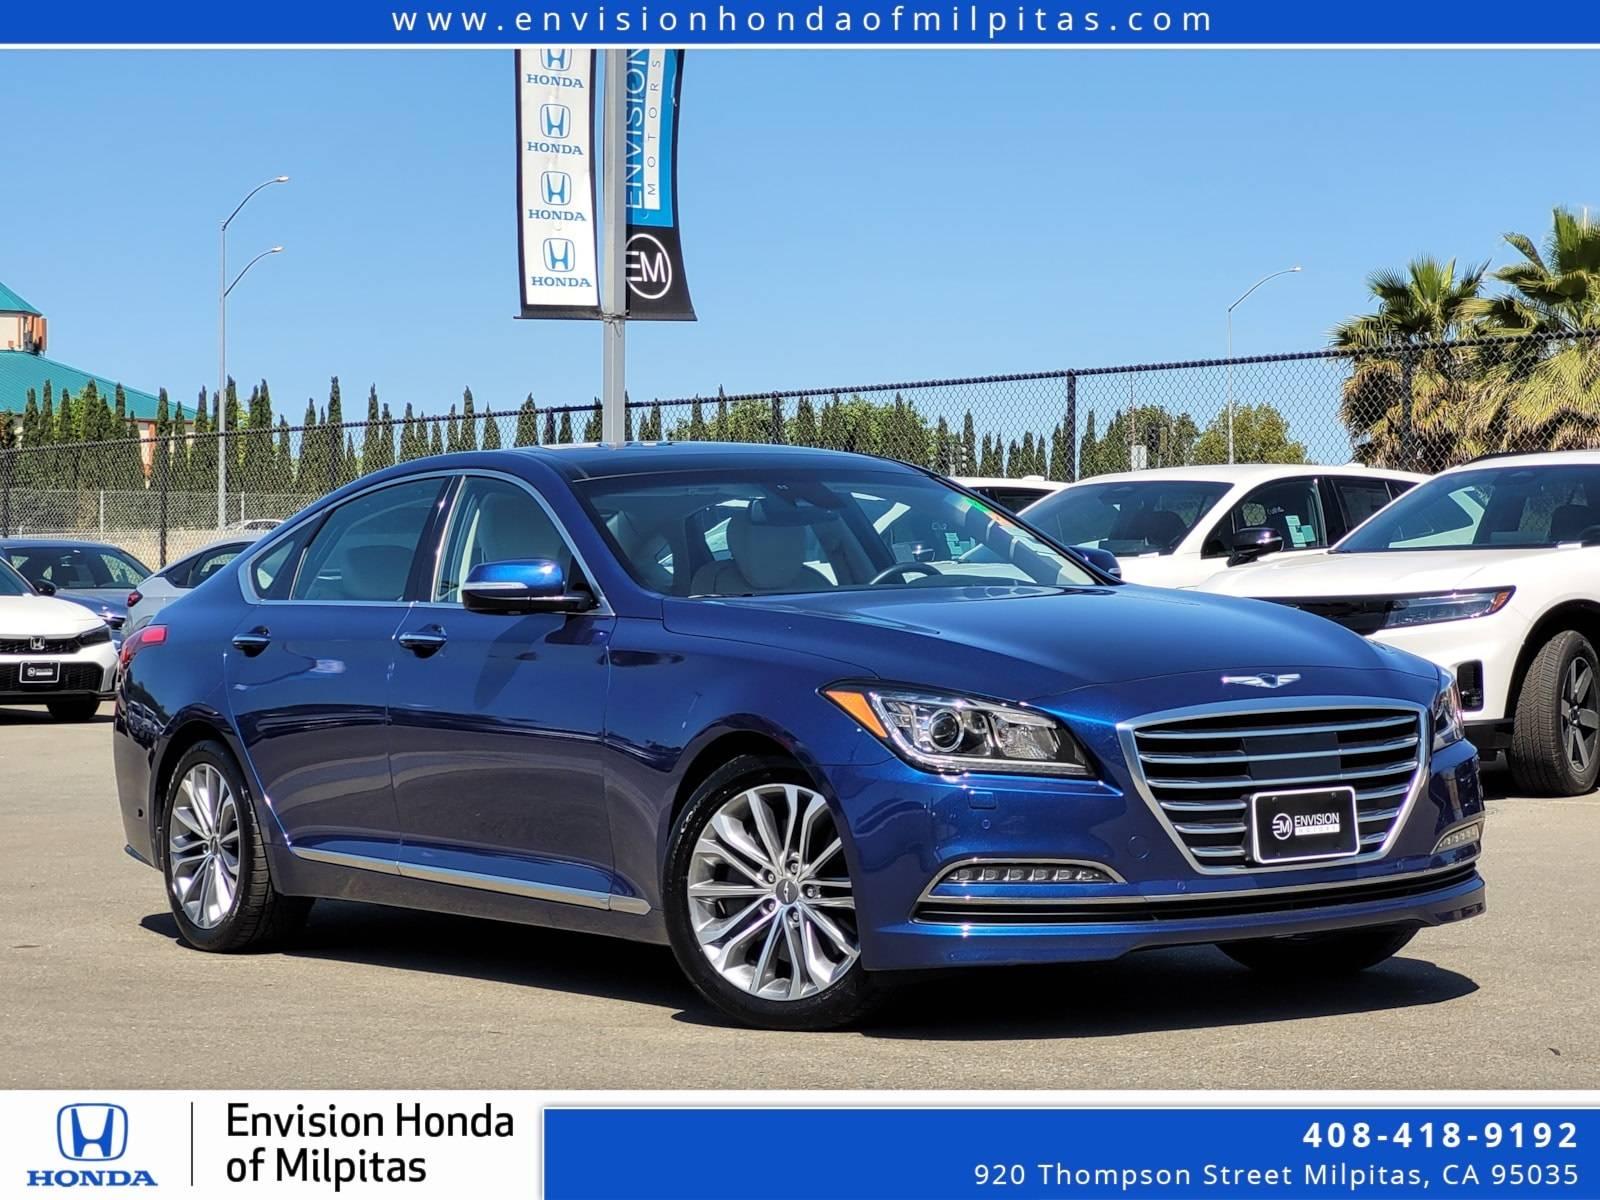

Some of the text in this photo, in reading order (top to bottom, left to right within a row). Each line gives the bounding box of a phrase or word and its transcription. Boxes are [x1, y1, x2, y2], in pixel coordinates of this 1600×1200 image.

[526, 74, 585, 89] HONDA
[626, 48, 647, 210] ENVISION
[647, 60, 661, 196] MOTORS
[527, 141, 584, 156] HONDA
[528, 208, 587, 222] HONDA
[531, 275, 593, 288] HONDA
[1294, 812, 1340, 827] ENVISION
